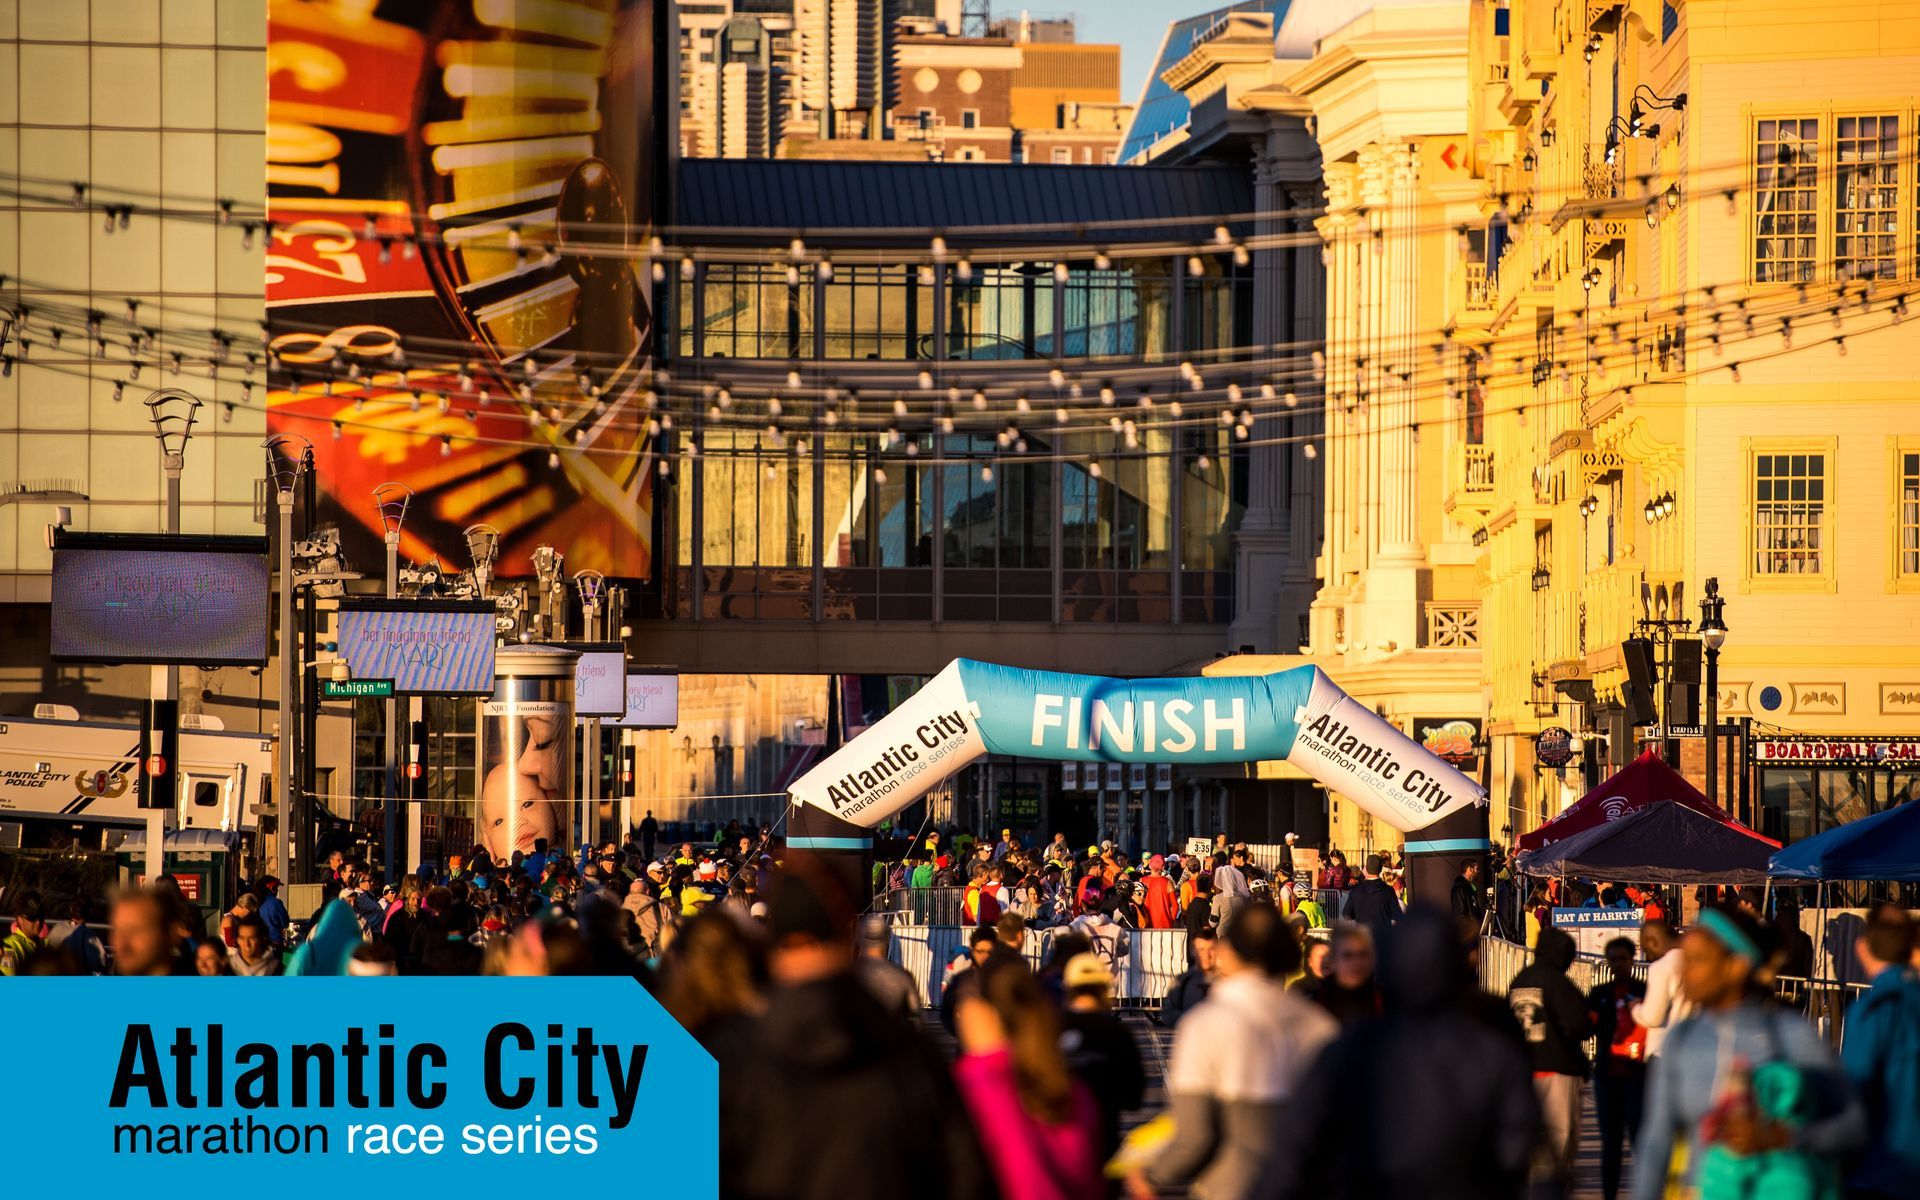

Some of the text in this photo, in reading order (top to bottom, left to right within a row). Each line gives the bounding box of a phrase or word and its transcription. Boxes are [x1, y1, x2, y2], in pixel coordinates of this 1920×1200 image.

[363, 628, 471, 645] her imaginary friend
[385, 643, 450, 670] MARY
[582, 664, 606, 677] friend
[330, 682, 374, 695] Michigan
[516, 703, 556, 713] Foundation
[1031, 693, 1246, 753] FINISH
[1765, 743, 1877, 759] BOARDWALK
[826, 710, 968, 810] Atlantic City
[1307, 713, 1401, 780] Atlantic
[1402, 769, 1453, 813] City
[43, 773, 70, 782] CITY
[841, 736, 966, 818] marathon race series
[1298, 733, 1425, 814] marathon race series
[5, 779, 46, 788] POLICE
[1194, 843, 1210, 853] 3:35
[1555, 911, 1639, 923] EAT AT HARRY'S
